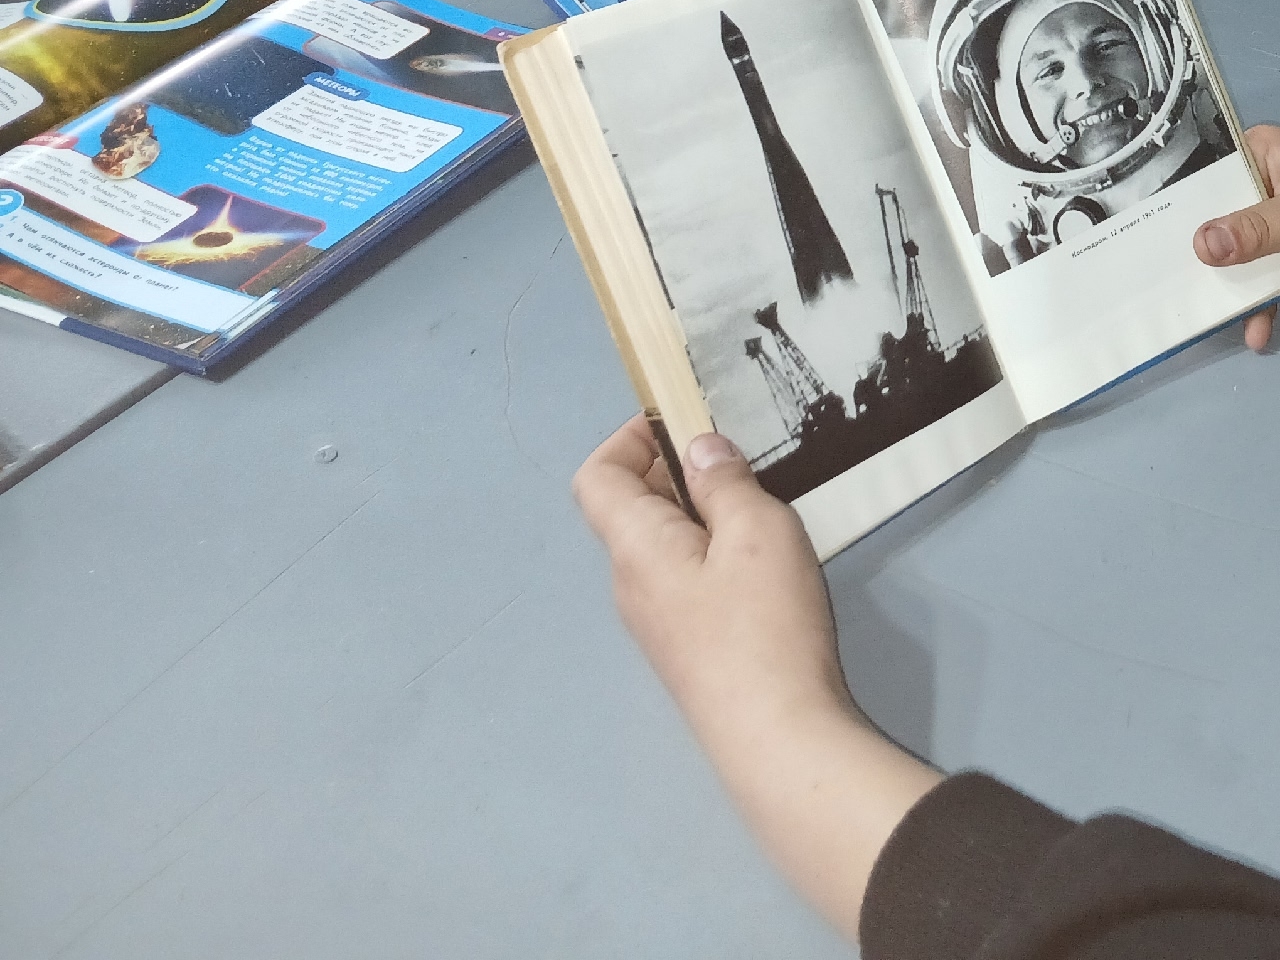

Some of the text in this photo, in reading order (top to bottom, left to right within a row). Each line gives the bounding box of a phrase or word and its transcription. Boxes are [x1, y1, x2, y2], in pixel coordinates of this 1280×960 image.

[313, 75, 361, 97] МЕТЕОРЫ
[5, 230, 14, 239] А
[1114, 220, 1135, 234] апреля
[21, 221, 39, 234] Чем
[87, 254, 130, 277] астероиды
